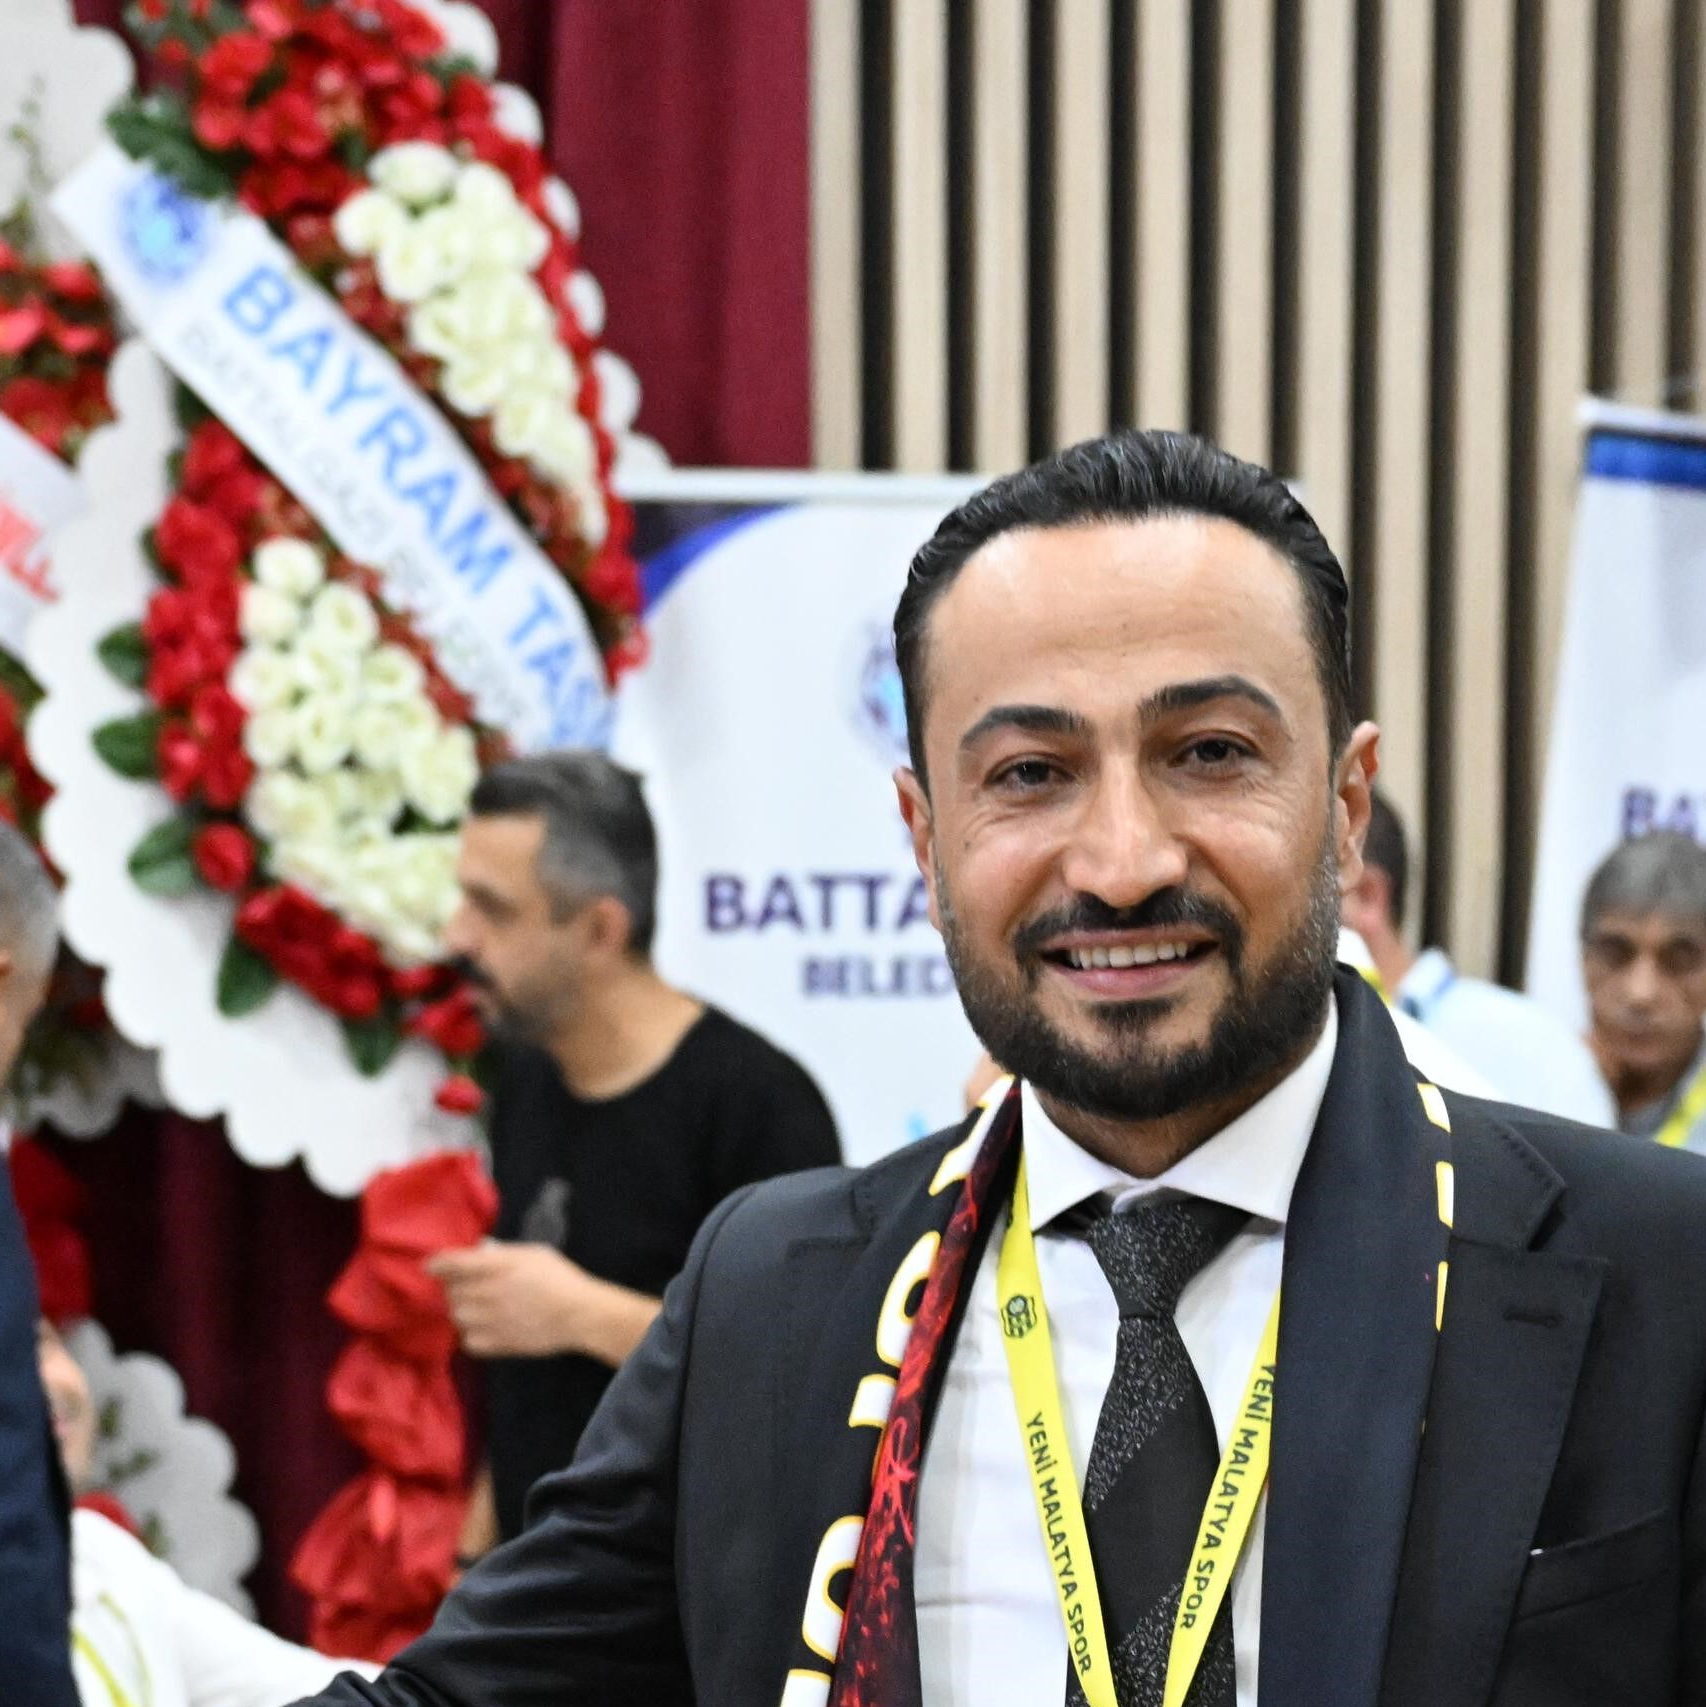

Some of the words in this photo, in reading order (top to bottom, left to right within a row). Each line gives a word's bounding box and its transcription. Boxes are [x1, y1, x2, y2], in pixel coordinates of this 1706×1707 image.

[222, 262, 517, 596] BAYRAM
[1246, 1363, 1277, 1427] YENİ
[1026, 1410, 1058, 1475] YENİ
[1201, 1427, 1259, 1551] MALATYA
[1039, 1476, 1079, 1601] MALATYA
[1180, 1559, 1215, 1631] SPOR
[1067, 1602, 1093, 1677] SPOR
